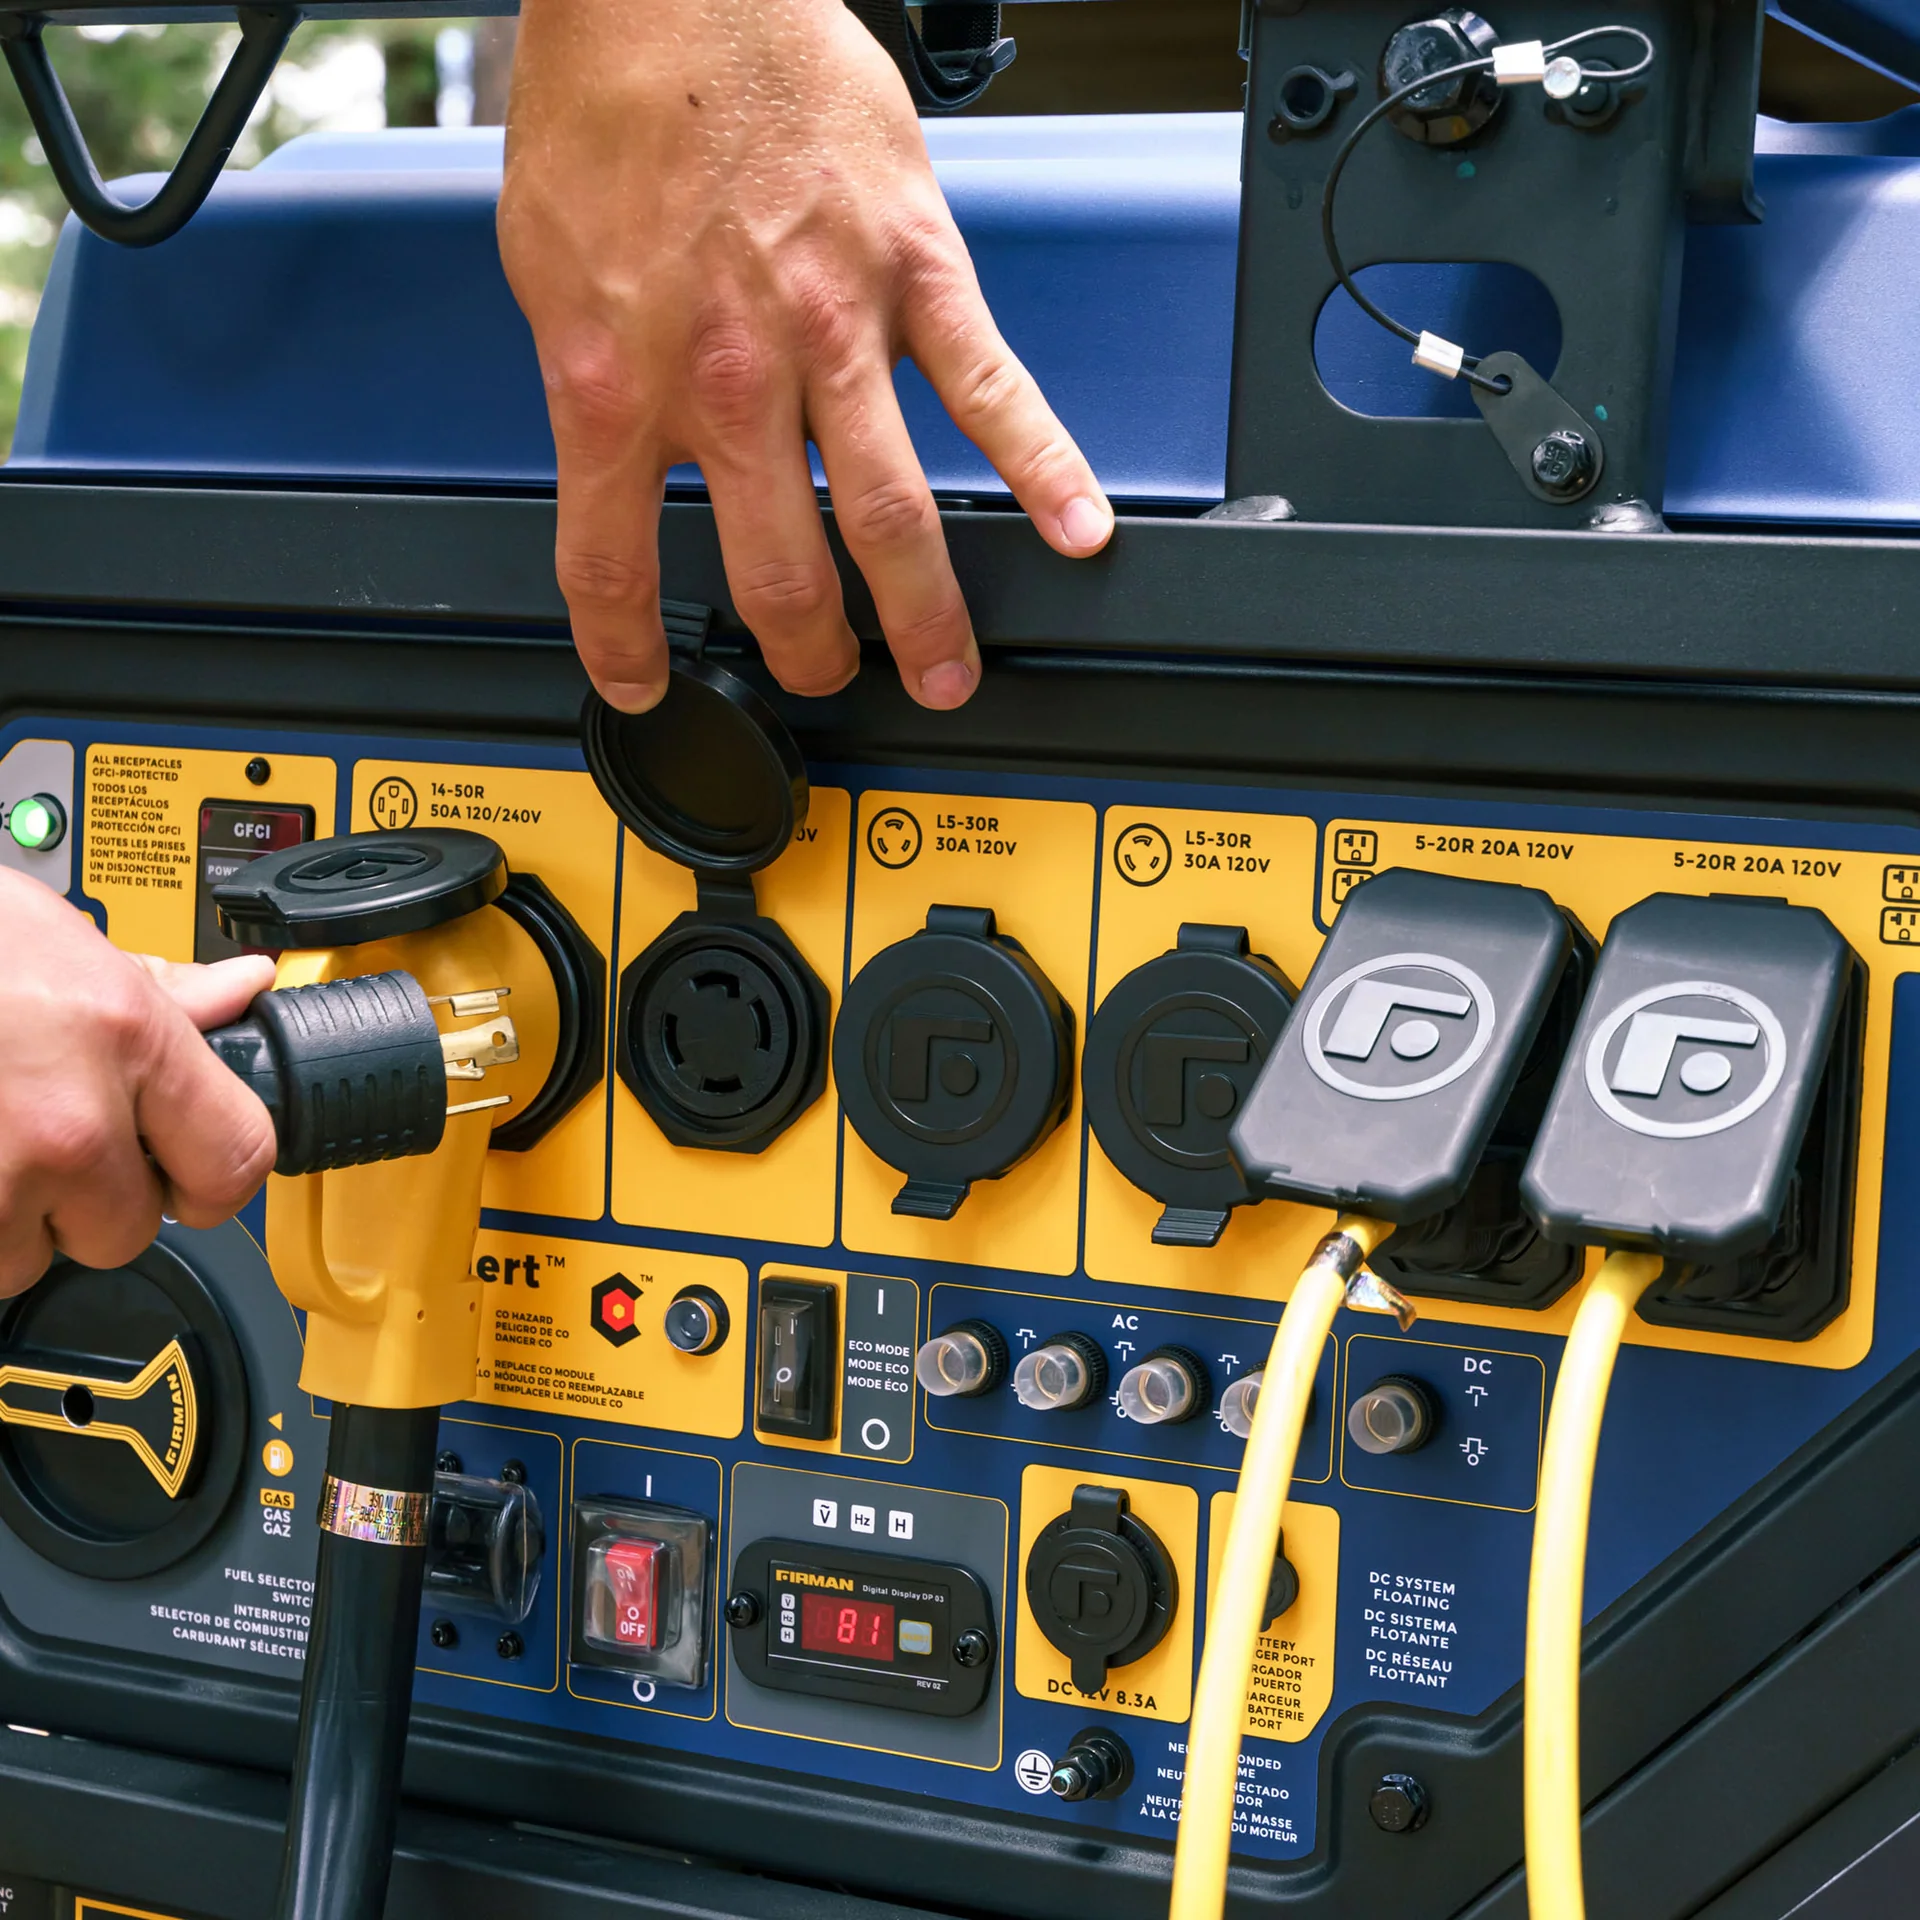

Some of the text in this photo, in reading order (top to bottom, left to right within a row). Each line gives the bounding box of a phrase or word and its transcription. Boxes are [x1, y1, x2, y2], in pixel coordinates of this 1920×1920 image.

[93, 755, 182, 768] ALL RECEPTACLES
[92, 768, 178, 781] GFCI-PROTECTED
[92, 783, 147, 794] TODOS LOS
[431, 782, 484, 799] 14-50R
[92, 796, 169, 809] RECEPTÁCULOS
[91, 808, 162, 821] CUENTAN CON
[431, 804, 541, 824] 50A 120/240V
[91, 821, 180, 835] PROTECCIÓN GFCI
[234, 823, 270, 839] GFCI
[937, 814, 998, 832] L5-30R
[91, 836, 185, 851] TOUTES LES PRISES
[936, 837, 1016, 855] 30A 120V
[1186, 830, 1251, 848] L5-30R
[1416, 835, 1574, 860] 5-20R 20A 120V
[90, 849, 191, 864] SONT PROTÉGÉES PAR
[1184, 854, 1271, 873] 30A 120V
[1674, 852, 1841, 877] 5-20R 20A 120V
[90, 862, 176, 876] UN DISJONCTEUR
[90, 874, 183, 890] DE FUITE DE TERRE
[475, 1254, 540, 1288] ert
[496, 1310, 553, 1324] CO HAZARD
[1112, 1314, 1139, 1331] AC
[496, 1322, 569, 1338] PELIGRO DE CO
[495, 1333, 552, 1348] DANGER CO
[849, 1340, 910, 1357] ECO MODE
[494, 1360, 536, 1373] REPLACE
[539, 1365, 552, 1375] CO
[555, 1368, 595, 1381] MODULE
[848, 1358, 909, 1374] MODE ECO
[1464, 1357, 1492, 1374] DC
[494, 1371, 535, 1384] MÓDULO
[538, 1377, 550, 1387] DE
[553, 1379, 566, 1388] CO
[568, 1382, 644, 1400] REEMPLAZABLE
[848, 1376, 908, 1392] MODE ÉCO
[494, 1383, 623, 1408] REMPLACER LE MODULE CO
[165, 1374, 184, 1466] FIRMAN
[264, 1492, 291, 1506] GAS
[263, 1508, 291, 1523] GAS
[855, 1514, 870, 1526] Hz
[263, 1522, 291, 1538] GAZ
[896, 1518, 906, 1533] H
[225, 1568, 254, 1583] FUEL
[776, 1570, 854, 1591] FIRMAN
[1370, 1572, 1455, 1595] DC SYSTEM
[272, 1592, 314, 1608] SWITC
[862, 1585, 888, 1595] Digital
[892, 1589, 921, 1600] Display
[1374, 1588, 1449, 1610] FLOATING
[234, 1604, 310, 1626] INTERRUPTO
[1364, 1609, 1457, 1634] DC SISTEMA
[150, 1605, 308, 1642] SELECTOR DE COMBUSTIB
[620, 1621, 645, 1637] OFF
[837, 1608, 880, 1645] 81
[173, 1627, 247, 1649] CARBURANT
[1256, 1637, 1295, 1651] TTERY
[1371, 1626, 1449, 1649] FLOTANTE
[1256, 1650, 1315, 1667] GER PORT
[1366, 1649, 1452, 1673] DC RÉSEAU
[1252, 1664, 1302, 1680] RGADOR
[1370, 1665, 1447, 1688] FLOTTANT
[917, 1680, 931, 1688] REV
[1254, 1677, 1301, 1692] PUERTO
[1048, 1679, 1072, 1695] DC
[1117, 1691, 1157, 1710] 8.3A
[1247, 1692, 1300, 1708] ARGEUR
[1248, 1704, 1304, 1722] BATTERIE
[1250, 1717, 1282, 1730] PORT
[1237, 1755, 1282, 1770] ONDED
[1234, 1782, 1289, 1800] ECTADO
[1140, 1804, 1148, 1816] À
[1152, 1808, 1165, 1819] LA
[1231, 1823, 1246, 1833] DU
[1250, 1826, 1297, 1843] MOTEUR
[1251, 1813, 1292, 1829] MASSE
